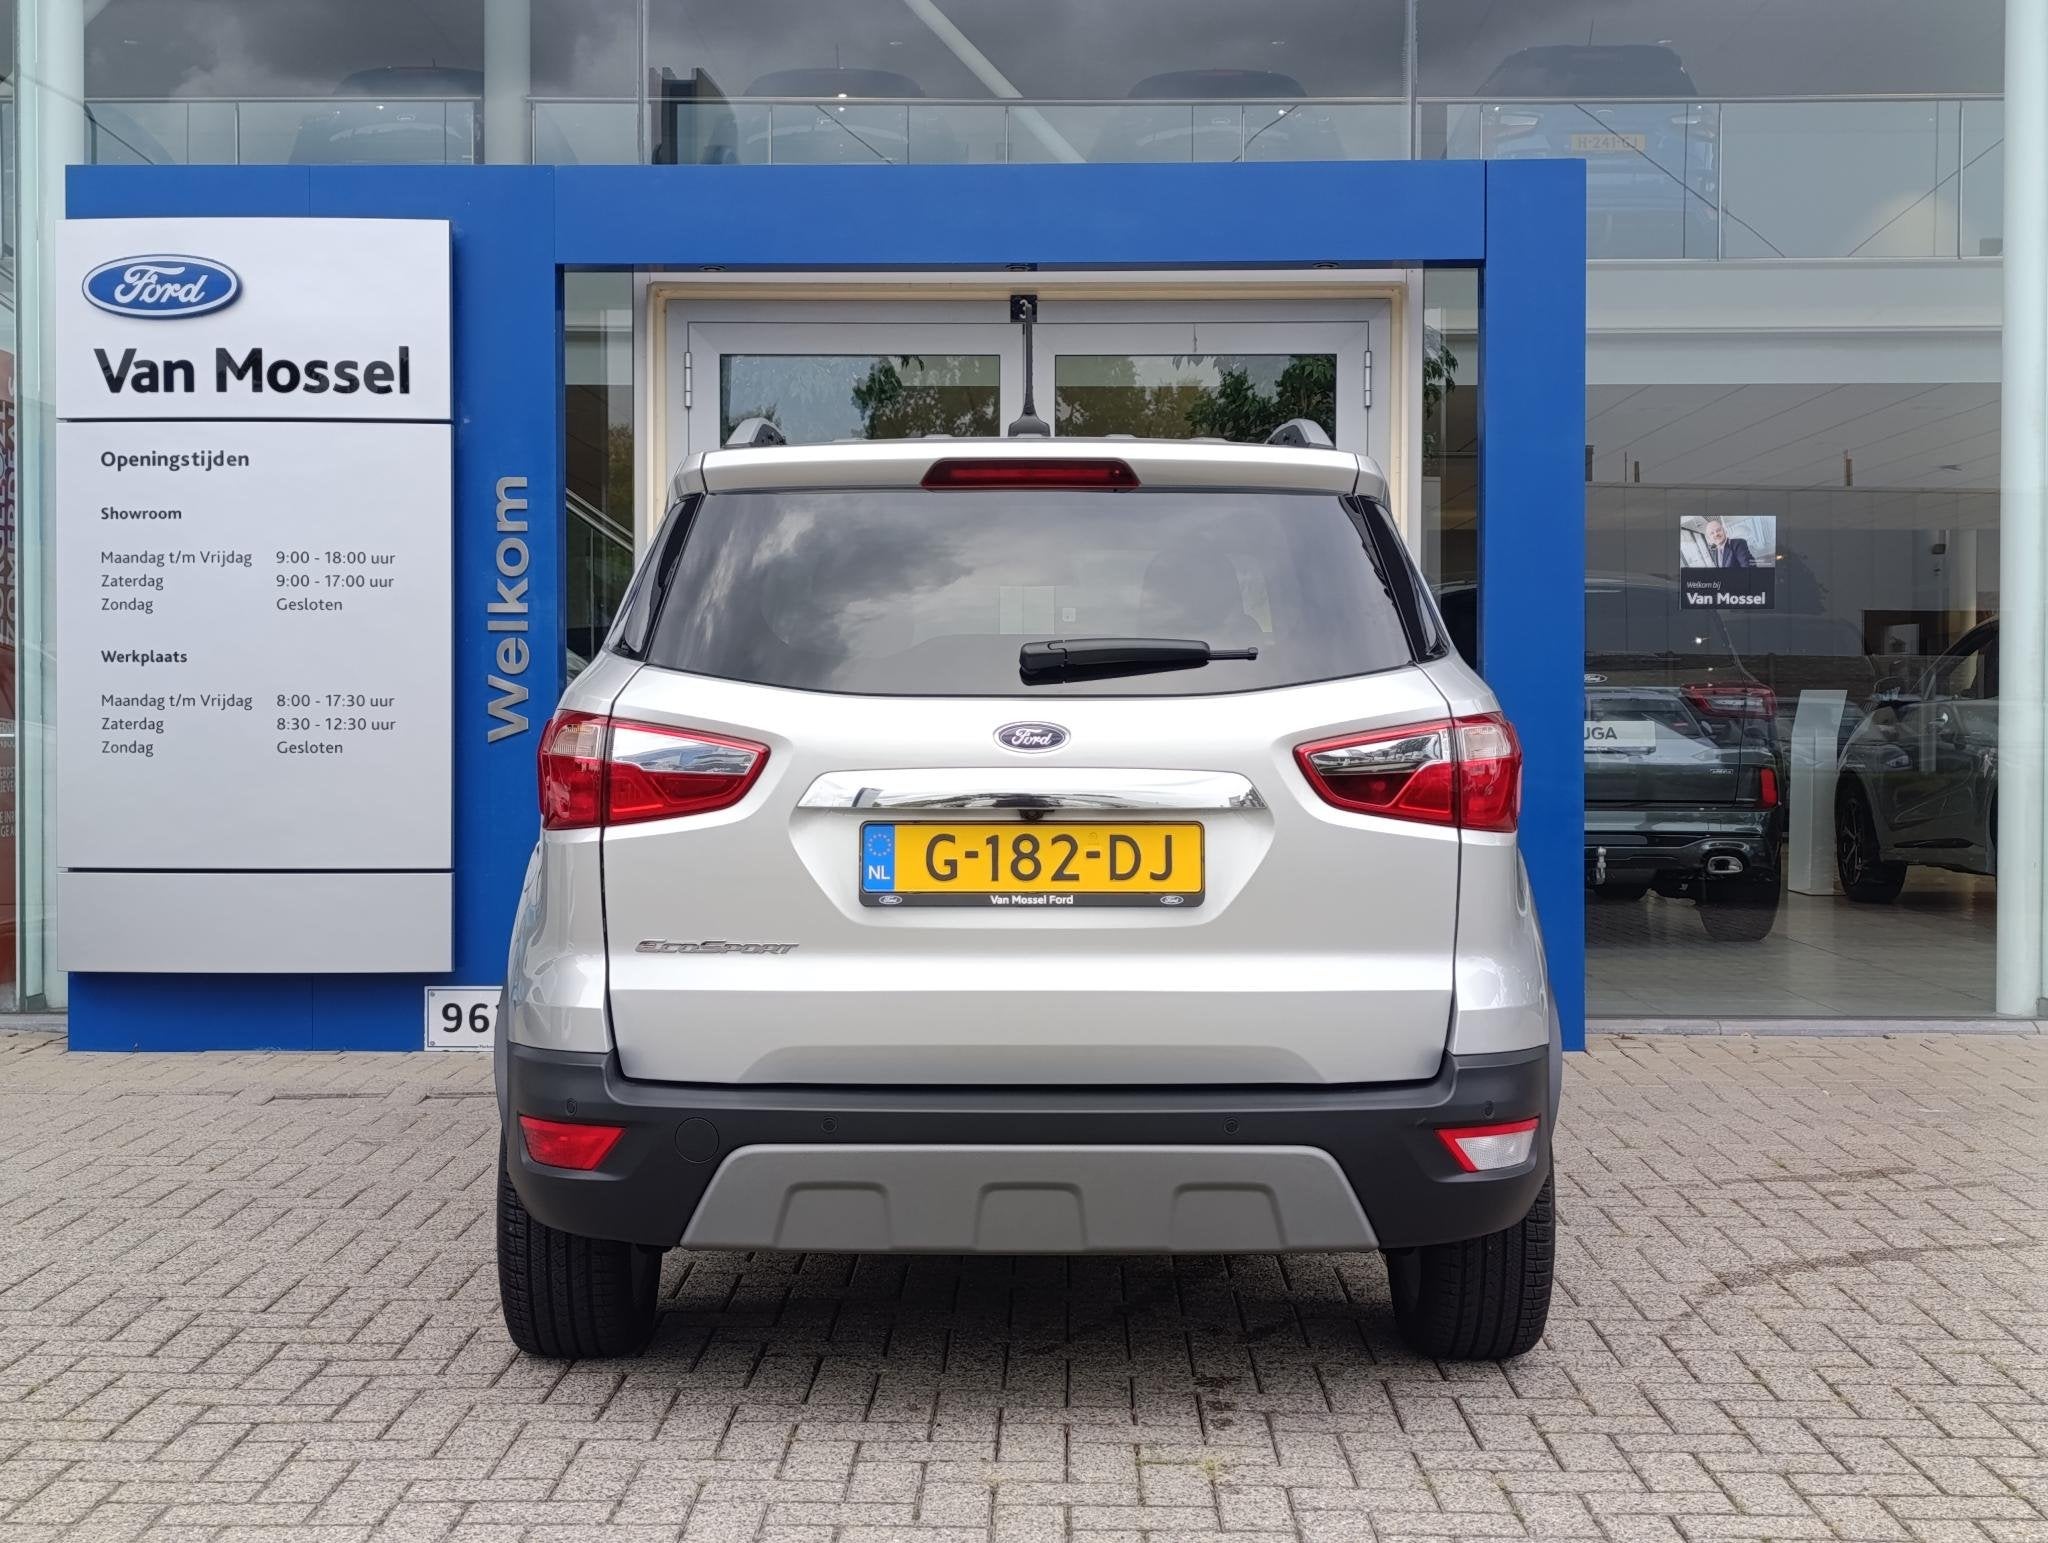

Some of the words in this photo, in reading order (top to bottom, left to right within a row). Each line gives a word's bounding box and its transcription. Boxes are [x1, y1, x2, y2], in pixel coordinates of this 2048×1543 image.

[94, 348, 195, 394] Van
[215, 346, 411, 395] Mossel
[101, 450, 249, 472] Openingstijden
[101, 506, 182, 521] Showroom
[101, 550, 165, 568] Maandag
[169, 550, 195, 565] t/m
[200, 550, 253, 568] Vrijdag
[275, 551, 310, 564] 9:00
[324, 551, 367, 564] 18:00
[370, 554, 396, 565] uur
[100, 573, 164, 592] Zaterdag
[275, 574, 310, 588] 9:00
[324, 574, 365, 588] 17:00
[369, 577, 395, 588] uur
[101, 596, 154, 615] Zondag
[276, 597, 343, 611] Gesloten
[1686, 593, 1713, 604] Van
[1717, 592, 1766, 604] Mossel
[487, 476, 530, 743] Welkom
[101, 650, 188, 668] Werkplaats
[101, 693, 165, 711] Maandag
[169, 693, 195, 708] t/m
[200, 693, 253, 711] Vrijdag
[276, 694, 311, 708] 8:00
[325, 694, 366, 708] 17:30
[370, 697, 395, 708] uur
[101, 716, 165, 735] Zaterdag
[276, 717, 311, 731] 8:30
[324, 717, 367, 731] 12:30
[371, 720, 397, 731] uur
[101, 739, 154, 758] Zondag
[276, 740, 343, 754] Gesloten
[926, 833, 1173, 881] G-182-DJ
[868, 865, 890, 880] NL
[990, 895, 1010, 905] Van
[1012, 895, 1047, 905] Mossel
[1049, 895, 1074, 905] Ford
[441, 1002, 500, 1034] 96
